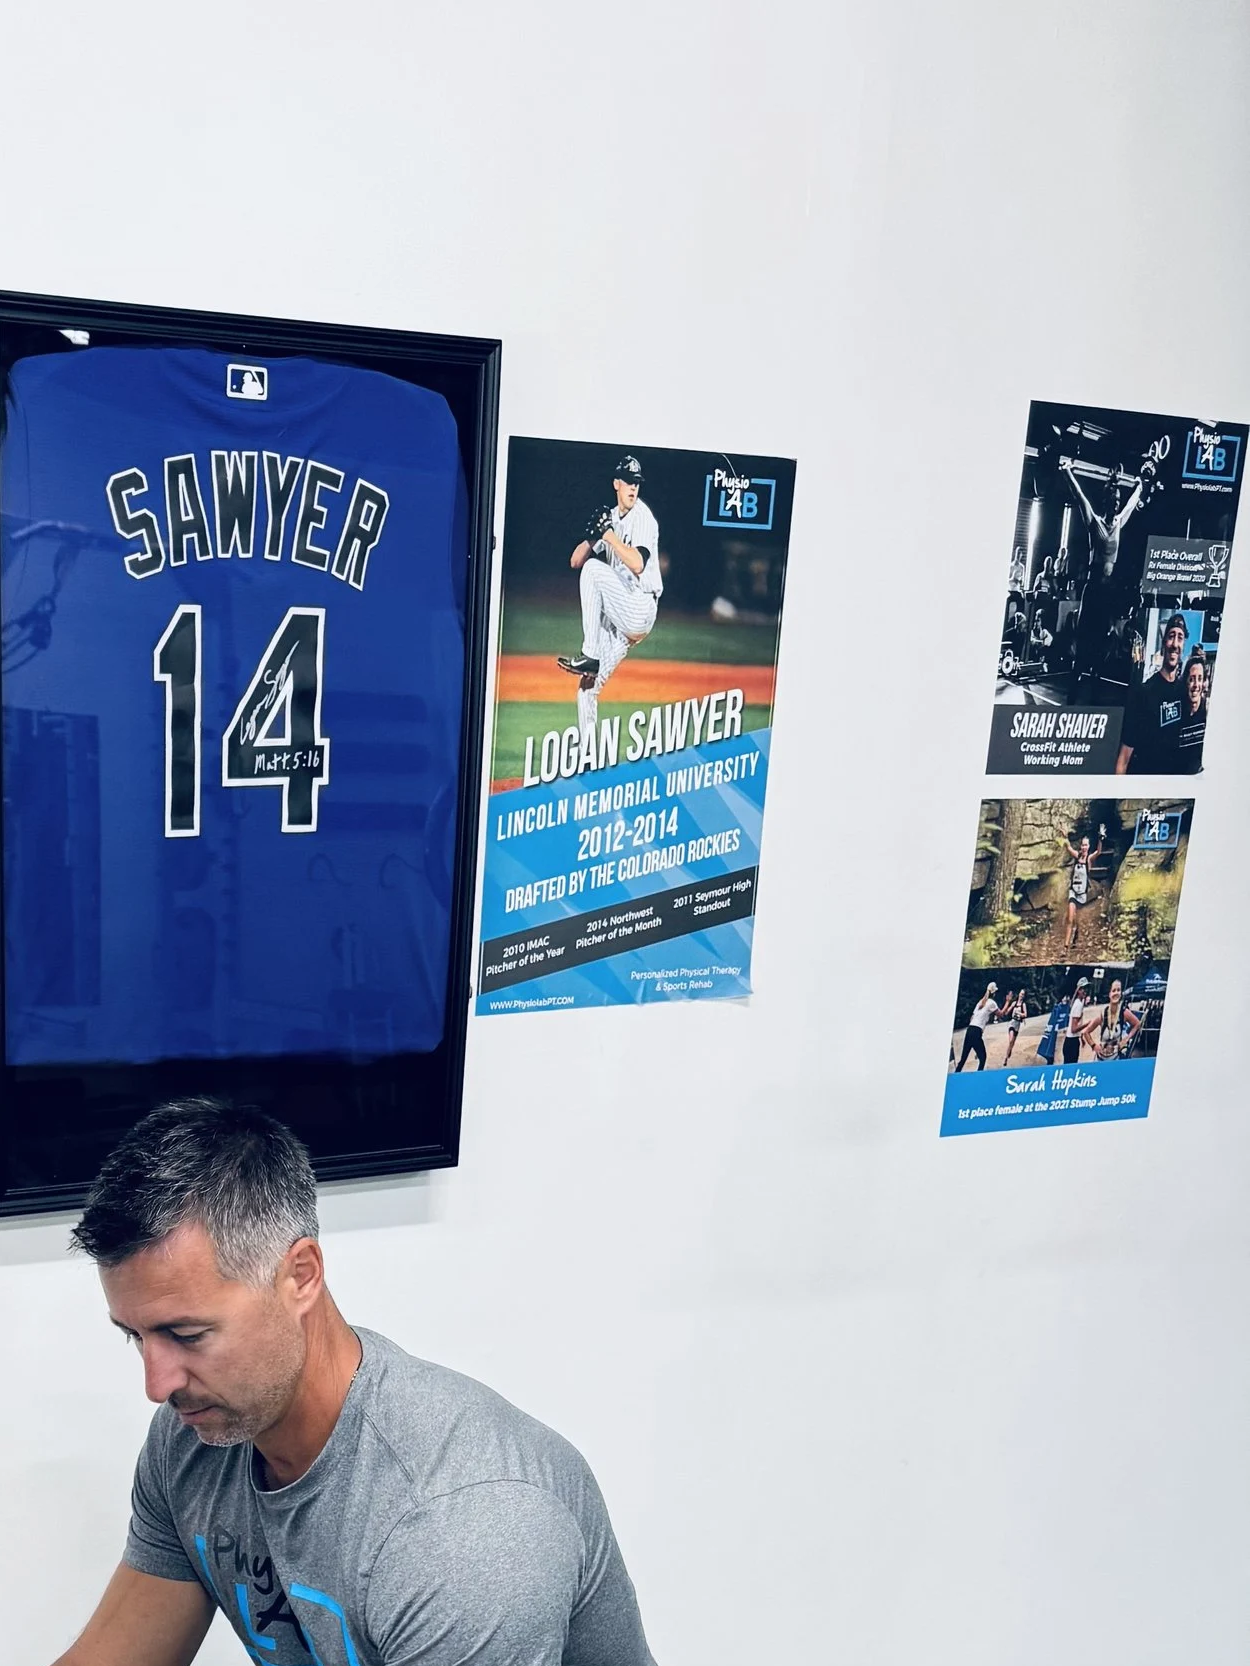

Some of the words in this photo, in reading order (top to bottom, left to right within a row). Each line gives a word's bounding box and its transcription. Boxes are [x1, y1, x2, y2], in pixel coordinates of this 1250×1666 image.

[1193, 426, 1221, 449] Physio
[1195, 445, 1226, 471] LAB
[714, 469, 750, 495] Physio
[719, 489, 758, 519] LAB
[106, 450, 390, 591] SAWYER
[153, 604, 330, 838] 14
[1010, 712, 1056, 738] SARAH
[1055, 713, 1108, 739] SHAVER
[524, 716, 620, 788] LOGAN
[627, 688, 744, 763] SAWYER
[1020, 741, 1057, 753] CrossFit
[1058, 742, 1091, 753] Athlete
[1023, 754, 1060, 768] Working
[1061, 755, 1083, 765] Mom
[497, 798, 569, 841] LINCOLN
[574, 776, 661, 821] MEMORIAL
[666, 751, 760, 797] UNIVERSITY
[577, 806, 679, 861] 2012-2014
[1144, 821, 1170, 841] LAB
[505, 875, 566, 913] DRAFTED
[569, 868, 587, 896] BY
[590, 861, 616, 890] THE
[617, 842, 685, 882] COLORADO
[687, 829, 741, 864] ROCKIES
[673, 894, 694, 909] 2011
[694, 885, 732, 904] Seymour
[733, 879, 752, 893] High
[693, 898, 731, 916] Standout
[586, 918, 608, 933] 2014
[609, 906, 654, 925] Northwest
[503, 943, 525, 958] 2010
[526, 936, 550, 952] IMAC
[575, 931, 607, 950] Pitcher
[608, 928, 618, 940] of
[619, 924, 633, 938] the
[634, 917, 662, 933] Month
[486, 961, 517, 977] Pitcher
[518, 954, 529, 966] of
[530, 951, 544, 964] the
[546, 946, 565, 960] Year
[631, 968, 678, 980] Personalized
[679, 967, 710, 977] Physical
[712, 966, 742, 976] Therapy
[655, 983, 662, 992] &
[663, 981, 687, 992] Sports
[689, 980, 713, 989] Rehab
[1005, 1073, 1046, 1094] Sarah
[1051, 1069, 1098, 1096] Hopkins
[958, 1108, 970, 1119] 1st
[970, 1106, 993, 1120] place
[994, 1103, 1024, 1116] female
[1024, 1103, 1034, 1112] at
[1035, 1101, 1049, 1112] the
[1049, 1099, 1070, 1111] 2021
[1070, 1098, 1097, 1110] Stump
[1097, 1095, 1120, 1107] Jump
[1121, 1093, 1137, 1104] 50k
